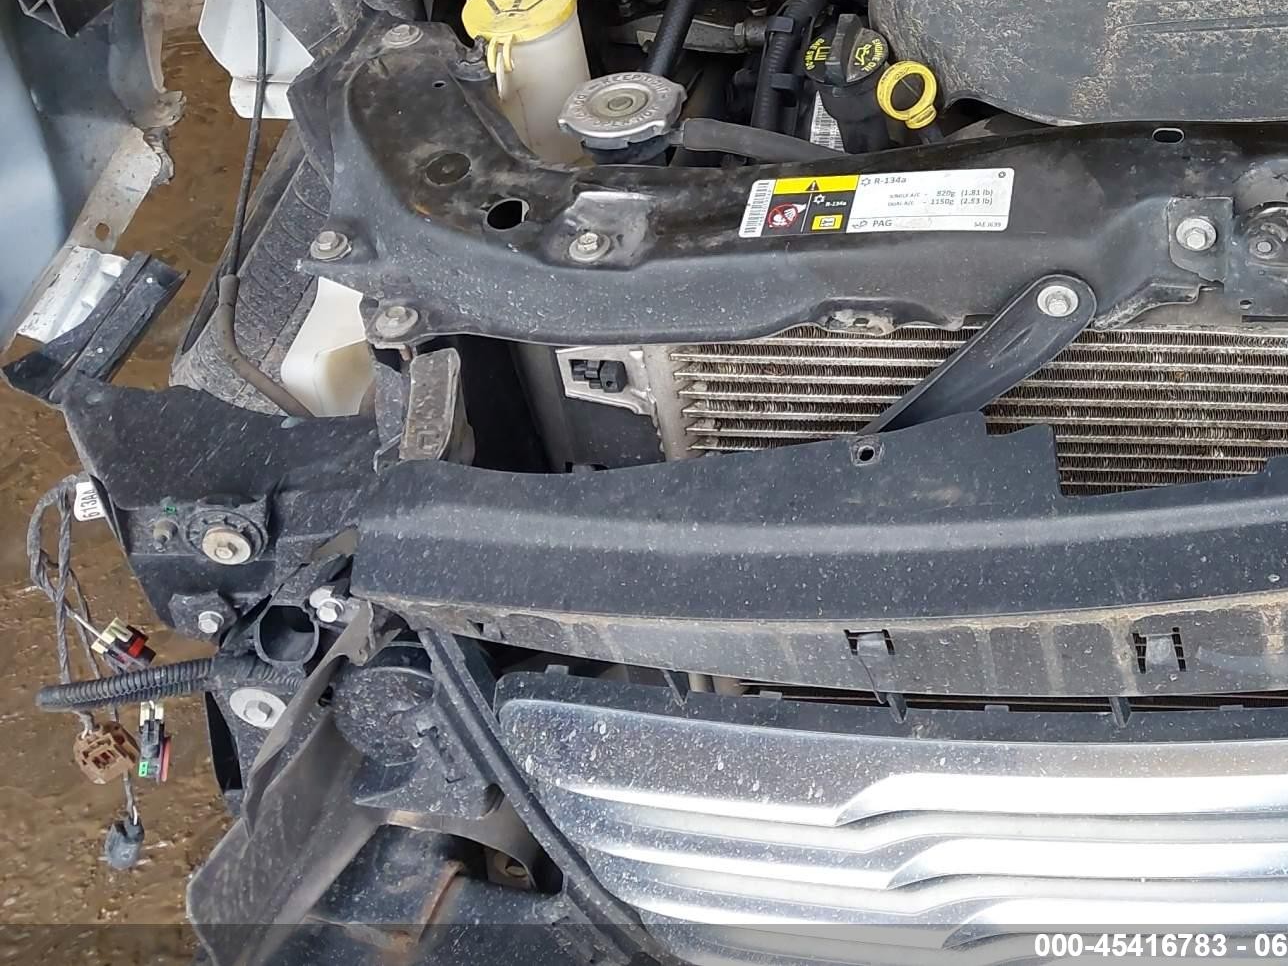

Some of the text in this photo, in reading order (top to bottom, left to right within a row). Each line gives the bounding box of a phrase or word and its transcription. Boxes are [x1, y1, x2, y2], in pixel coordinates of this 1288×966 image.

[861, 38, 884, 72] ENGINE OIL
[874, 176, 906, 184] R-134a
